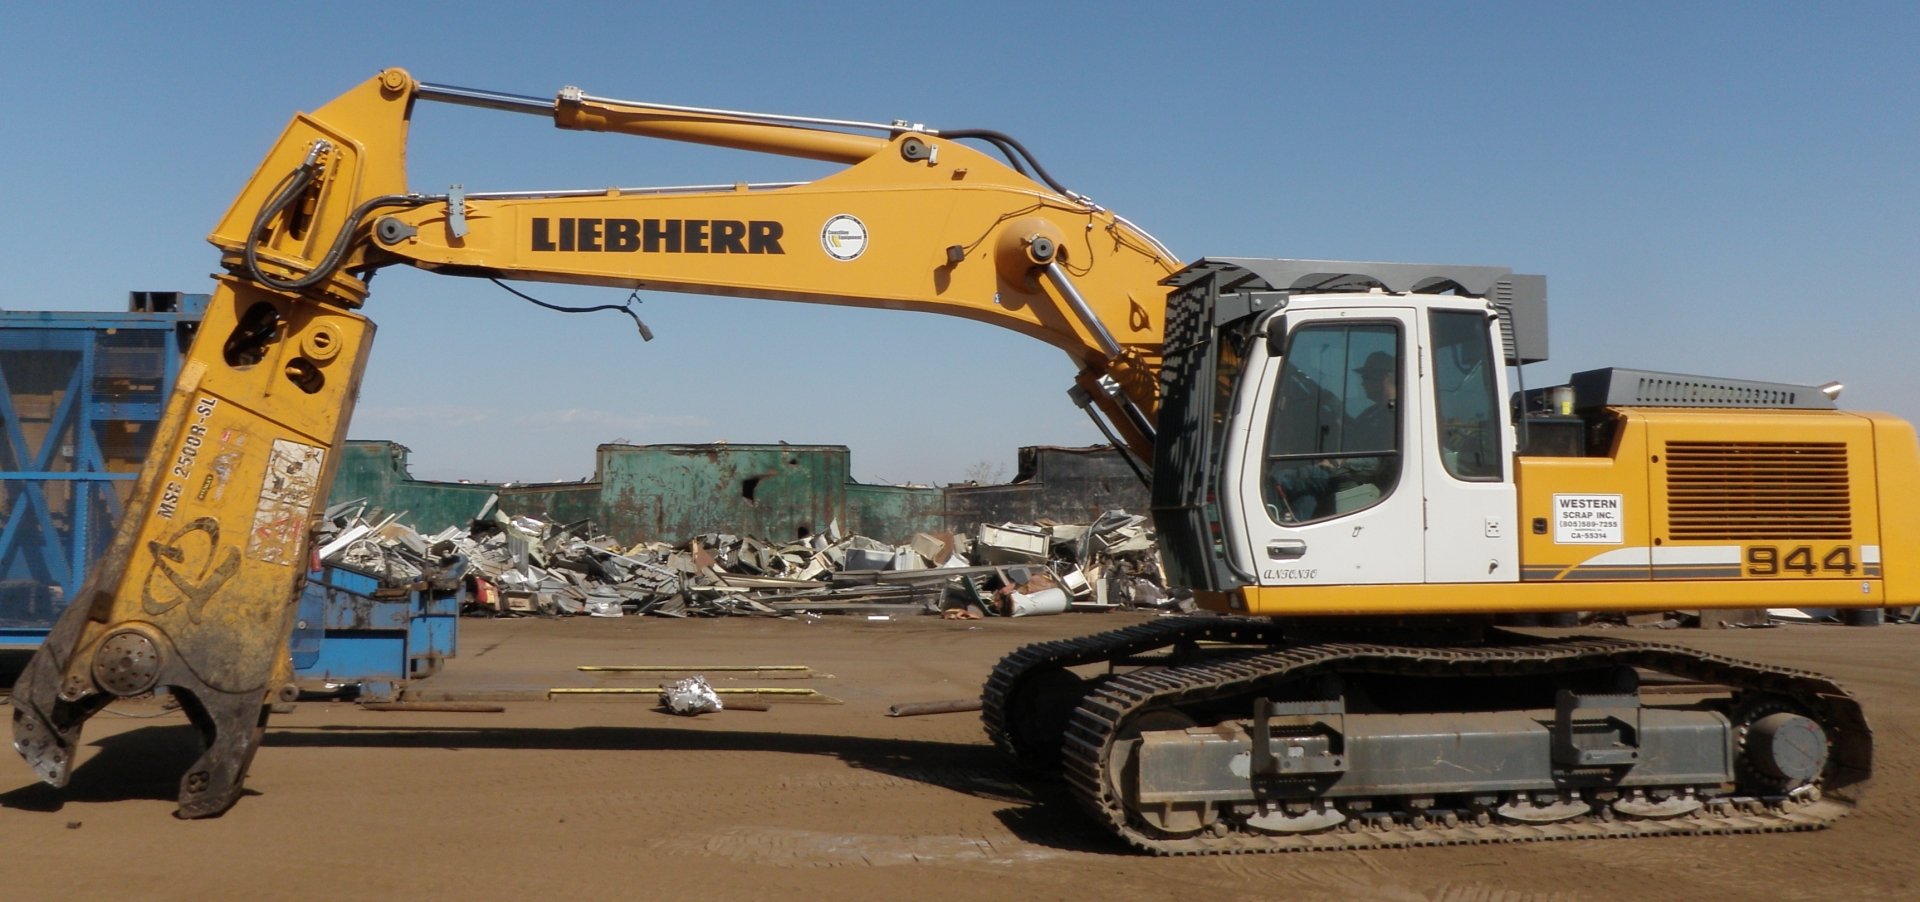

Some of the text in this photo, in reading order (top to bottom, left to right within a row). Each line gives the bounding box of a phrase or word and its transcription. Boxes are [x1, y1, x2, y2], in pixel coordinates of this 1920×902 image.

[532, 218, 785, 254] LIEBHERR
[174, 398, 216, 479] 2500R-SL
[1559, 499, 1617, 508] WESTERN
[1562, 511, 1615, 519] SCRAP INC.
[1747, 545, 1857, 577] 944
[1263, 568, 1318, 580] ANTONIO
